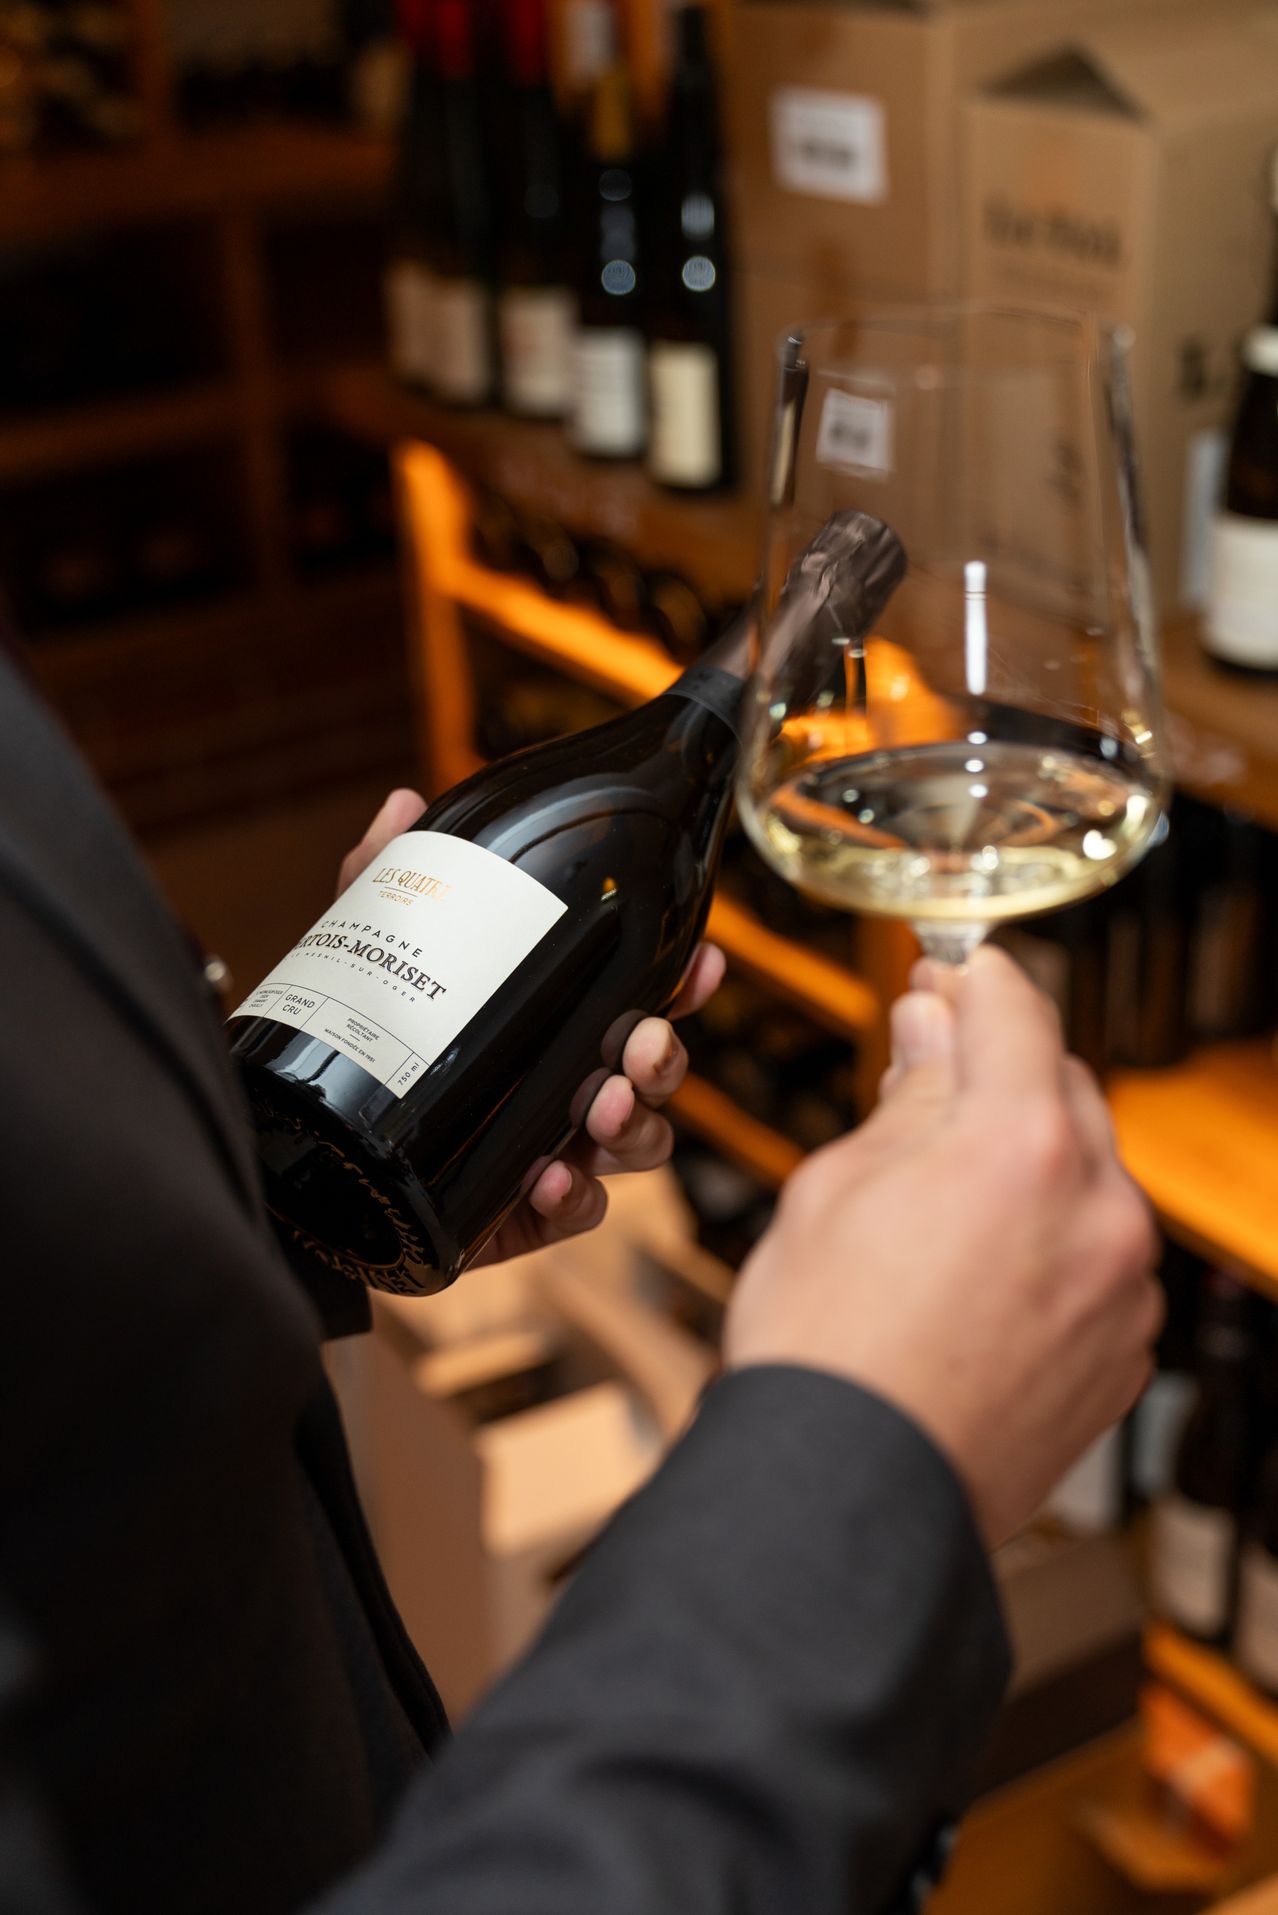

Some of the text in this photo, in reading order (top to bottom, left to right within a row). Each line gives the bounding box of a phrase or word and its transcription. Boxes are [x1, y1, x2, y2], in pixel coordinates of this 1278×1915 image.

[372, 868, 401, 884] LES
[379, 890, 413, 906] TERROIRS
[321, 920, 423, 958] CHAMPAGNE
[282, 1004, 302, 1016] CRU
[285, 993, 316, 1009] GRAND
[346, 1023, 374, 1043] RÉCOLTANT
[347, 1017, 380, 1041] PROPRIÉTAIRE
[324, 1028, 342, 1041] MAISON
[358, 1049, 366, 1057] EN
[397, 1062, 420, 1086] 750 ml
